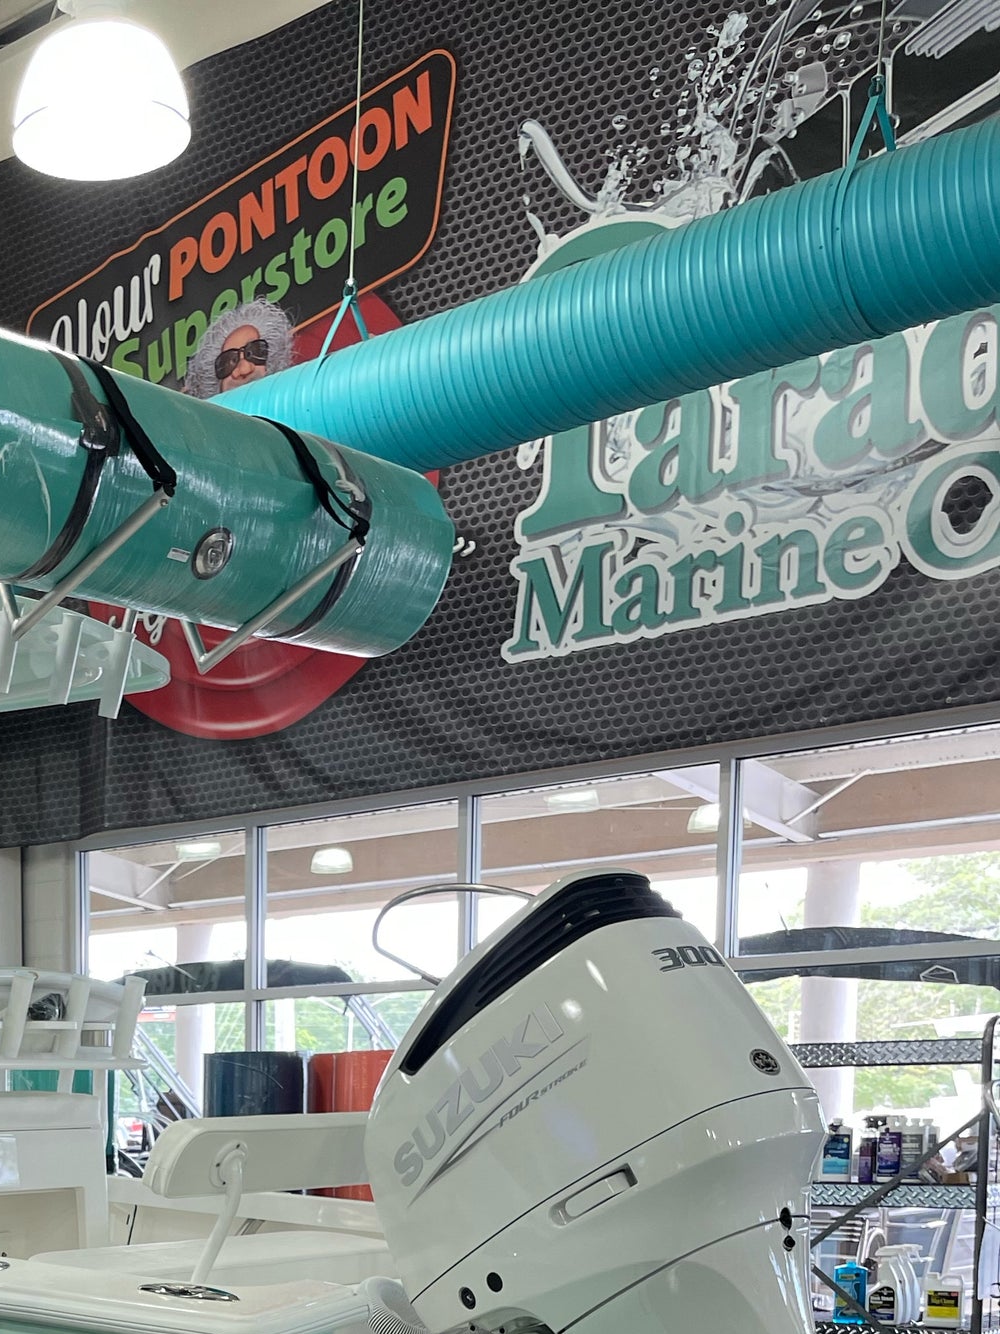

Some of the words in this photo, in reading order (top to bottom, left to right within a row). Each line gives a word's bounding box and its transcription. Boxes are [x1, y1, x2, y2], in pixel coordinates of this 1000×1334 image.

[168, 70, 433, 301] PONTOON
[111, 176, 409, 384] Superstore
[506, 510, 888, 656] Marine
[651, 945, 725, 972] 300
[393, 1001, 564, 1188] SUZUKI
